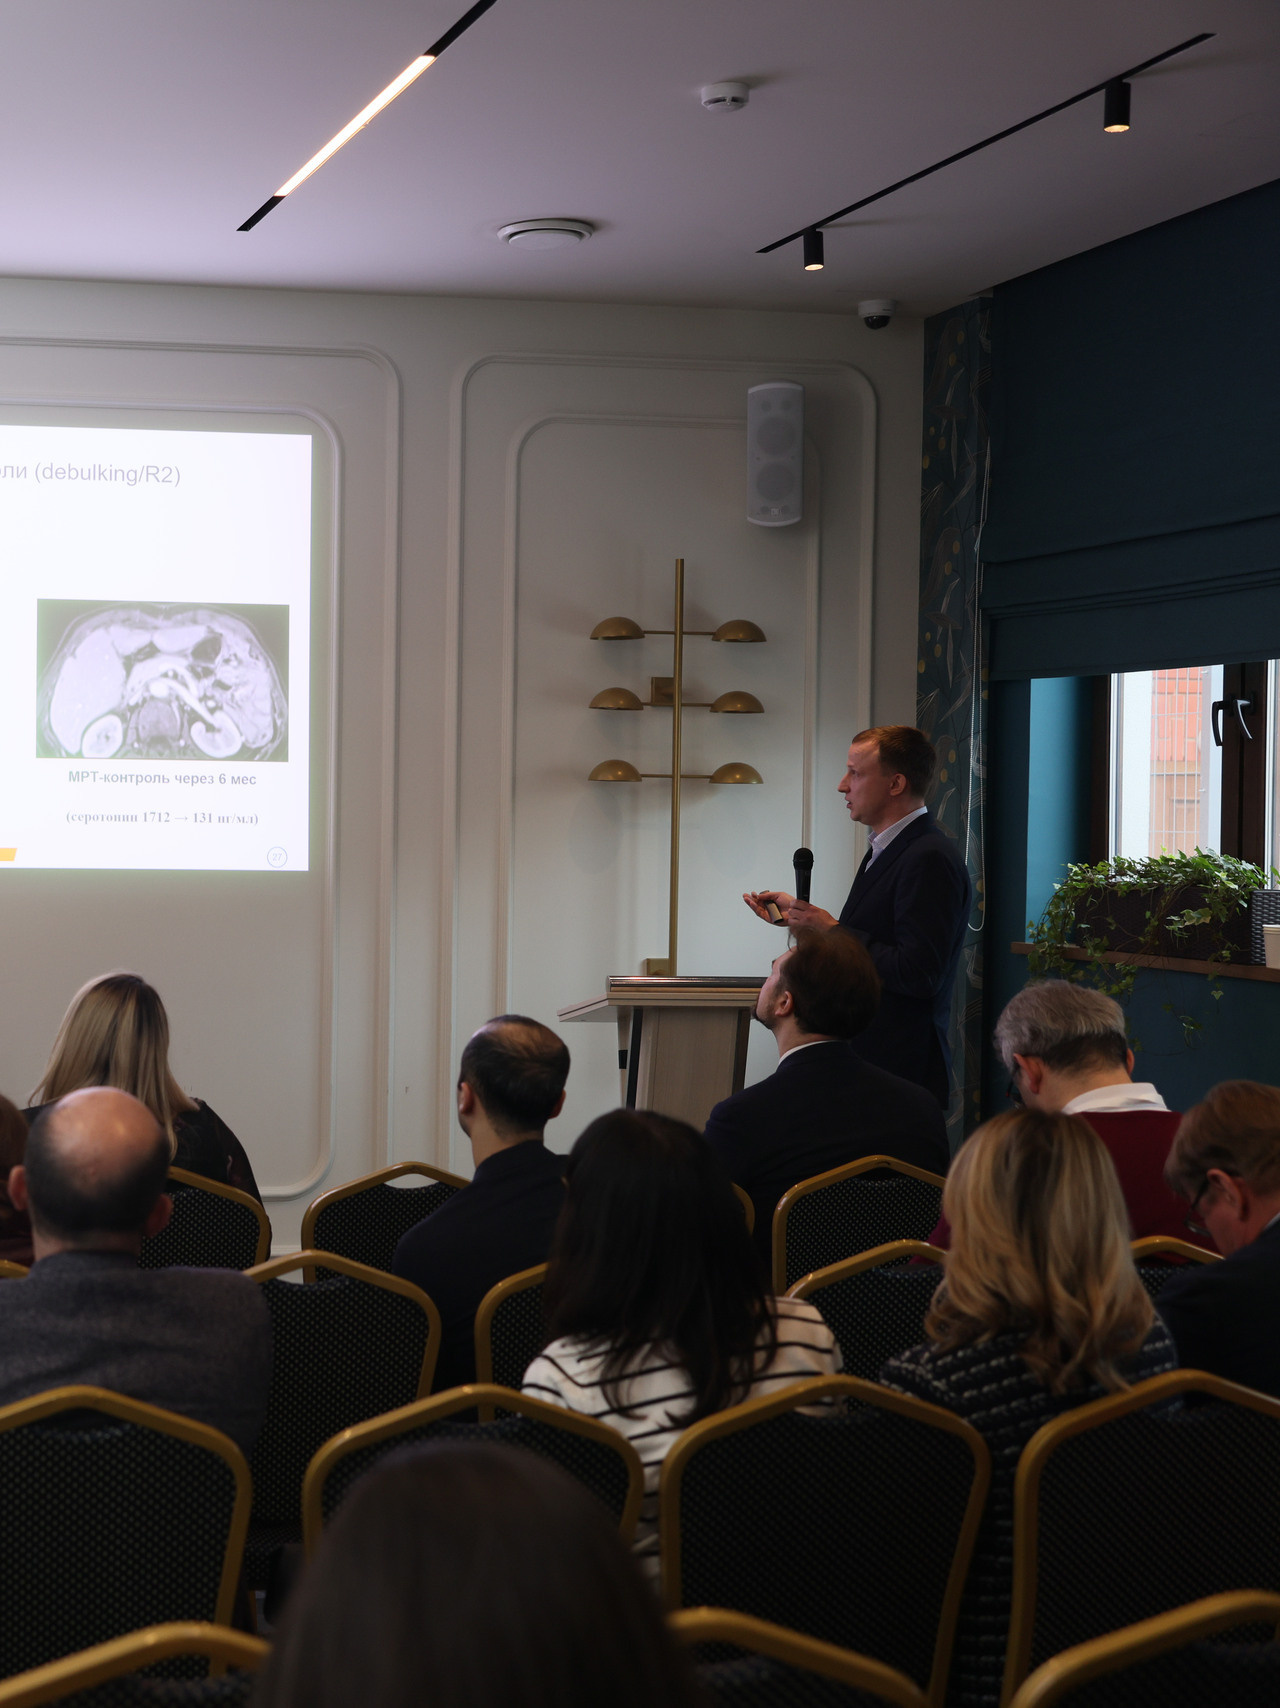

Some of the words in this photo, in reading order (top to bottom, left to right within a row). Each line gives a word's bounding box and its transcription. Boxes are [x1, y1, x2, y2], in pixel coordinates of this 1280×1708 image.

[34, 462, 182, 487] (debulking/R2)
[68, 770, 170, 786] МРТ-контроль
[174, 773, 215, 787] через
[218, 773, 227, 785] 6
[230, 774, 257, 785] мес
[65, 810, 138, 825] (серотонин
[142, 811, 171, 823] 1712
[192, 812, 213, 824] 131
